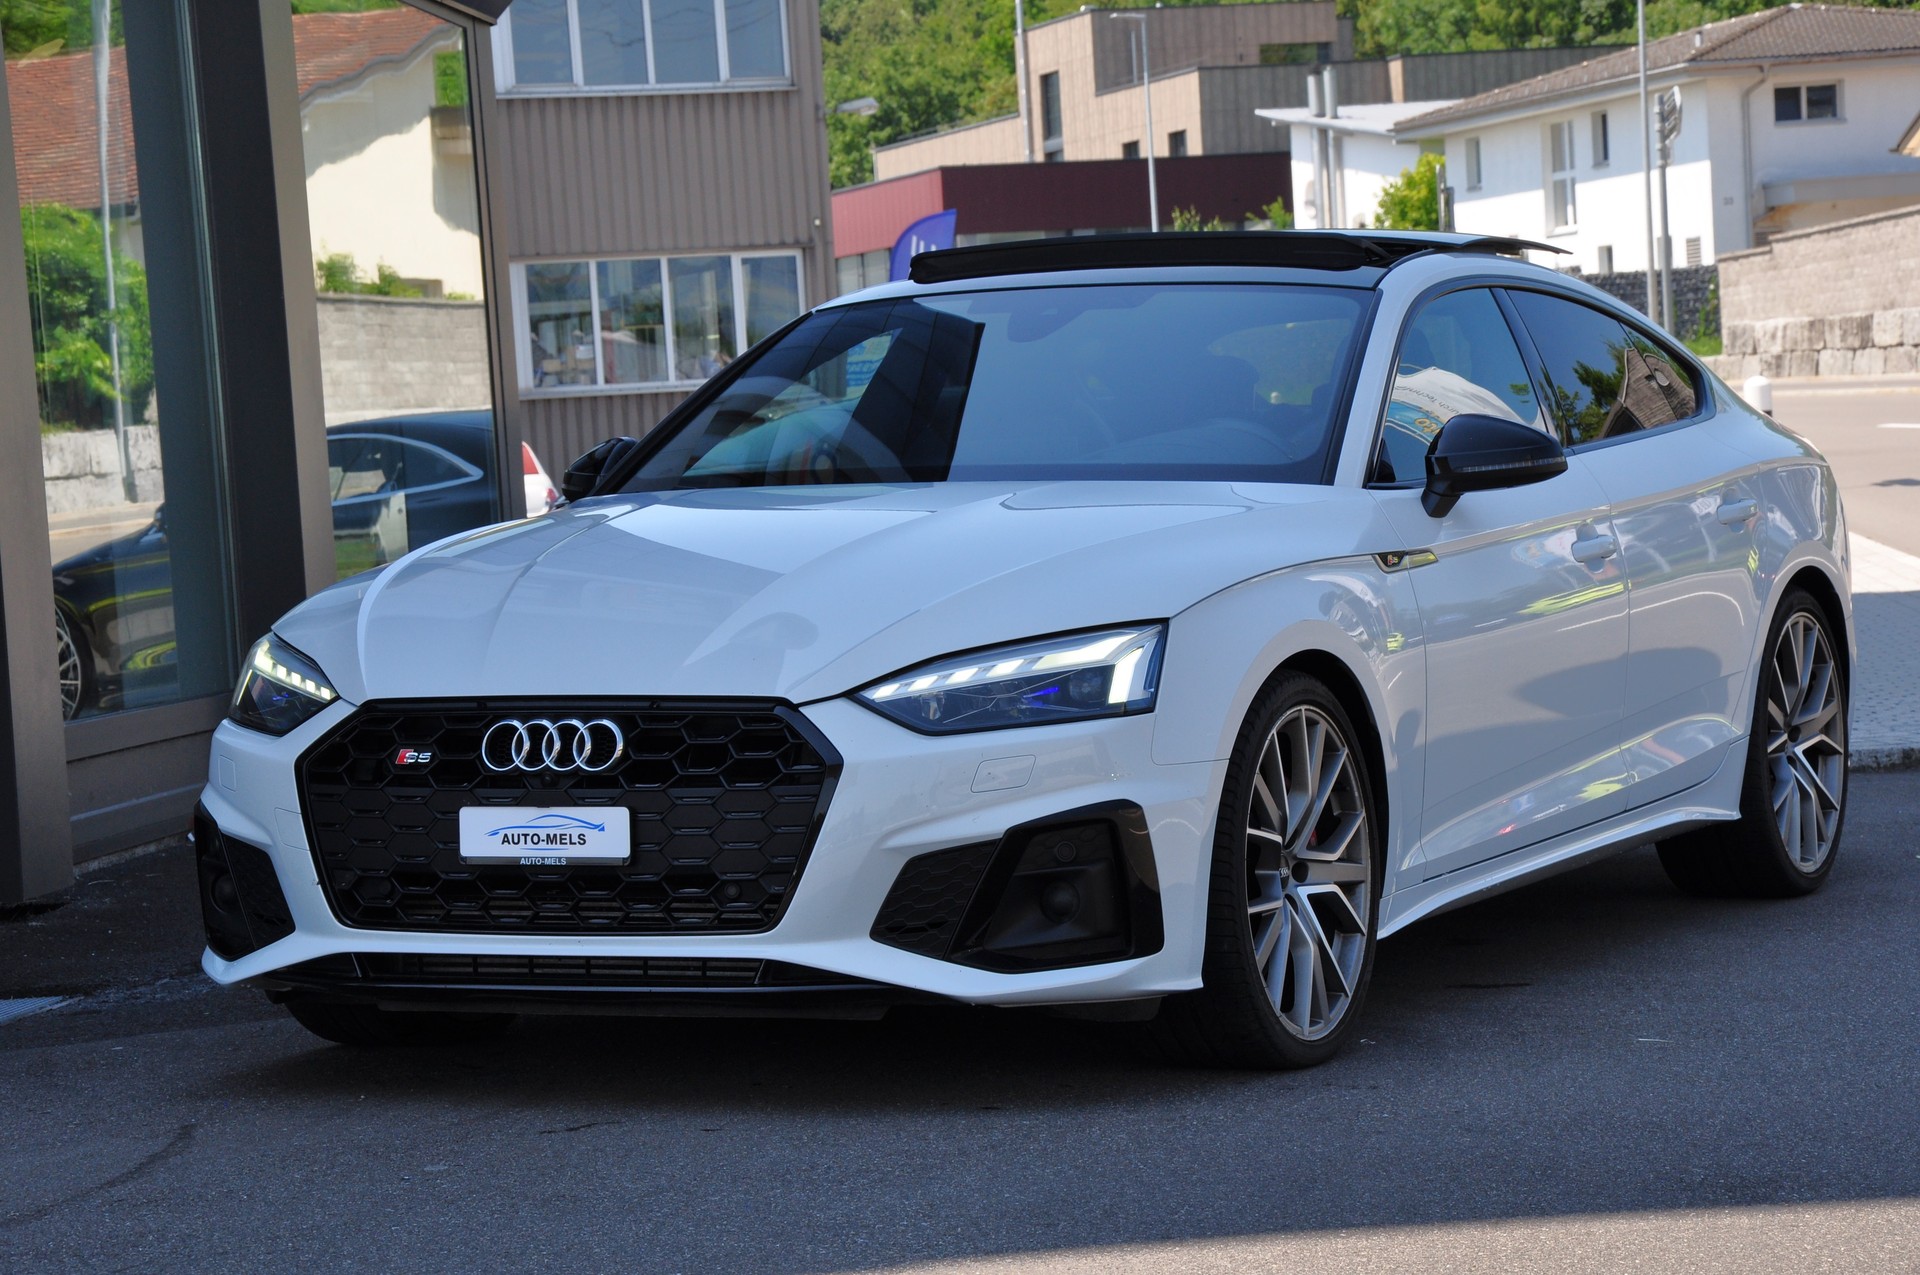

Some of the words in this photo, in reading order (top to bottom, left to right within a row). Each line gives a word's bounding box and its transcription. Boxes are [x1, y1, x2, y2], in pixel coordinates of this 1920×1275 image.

[403, 752, 432, 763] S5
[501, 833, 587, 846] AUTO-MELS
[520, 857, 567, 866] AUTO-MELS
